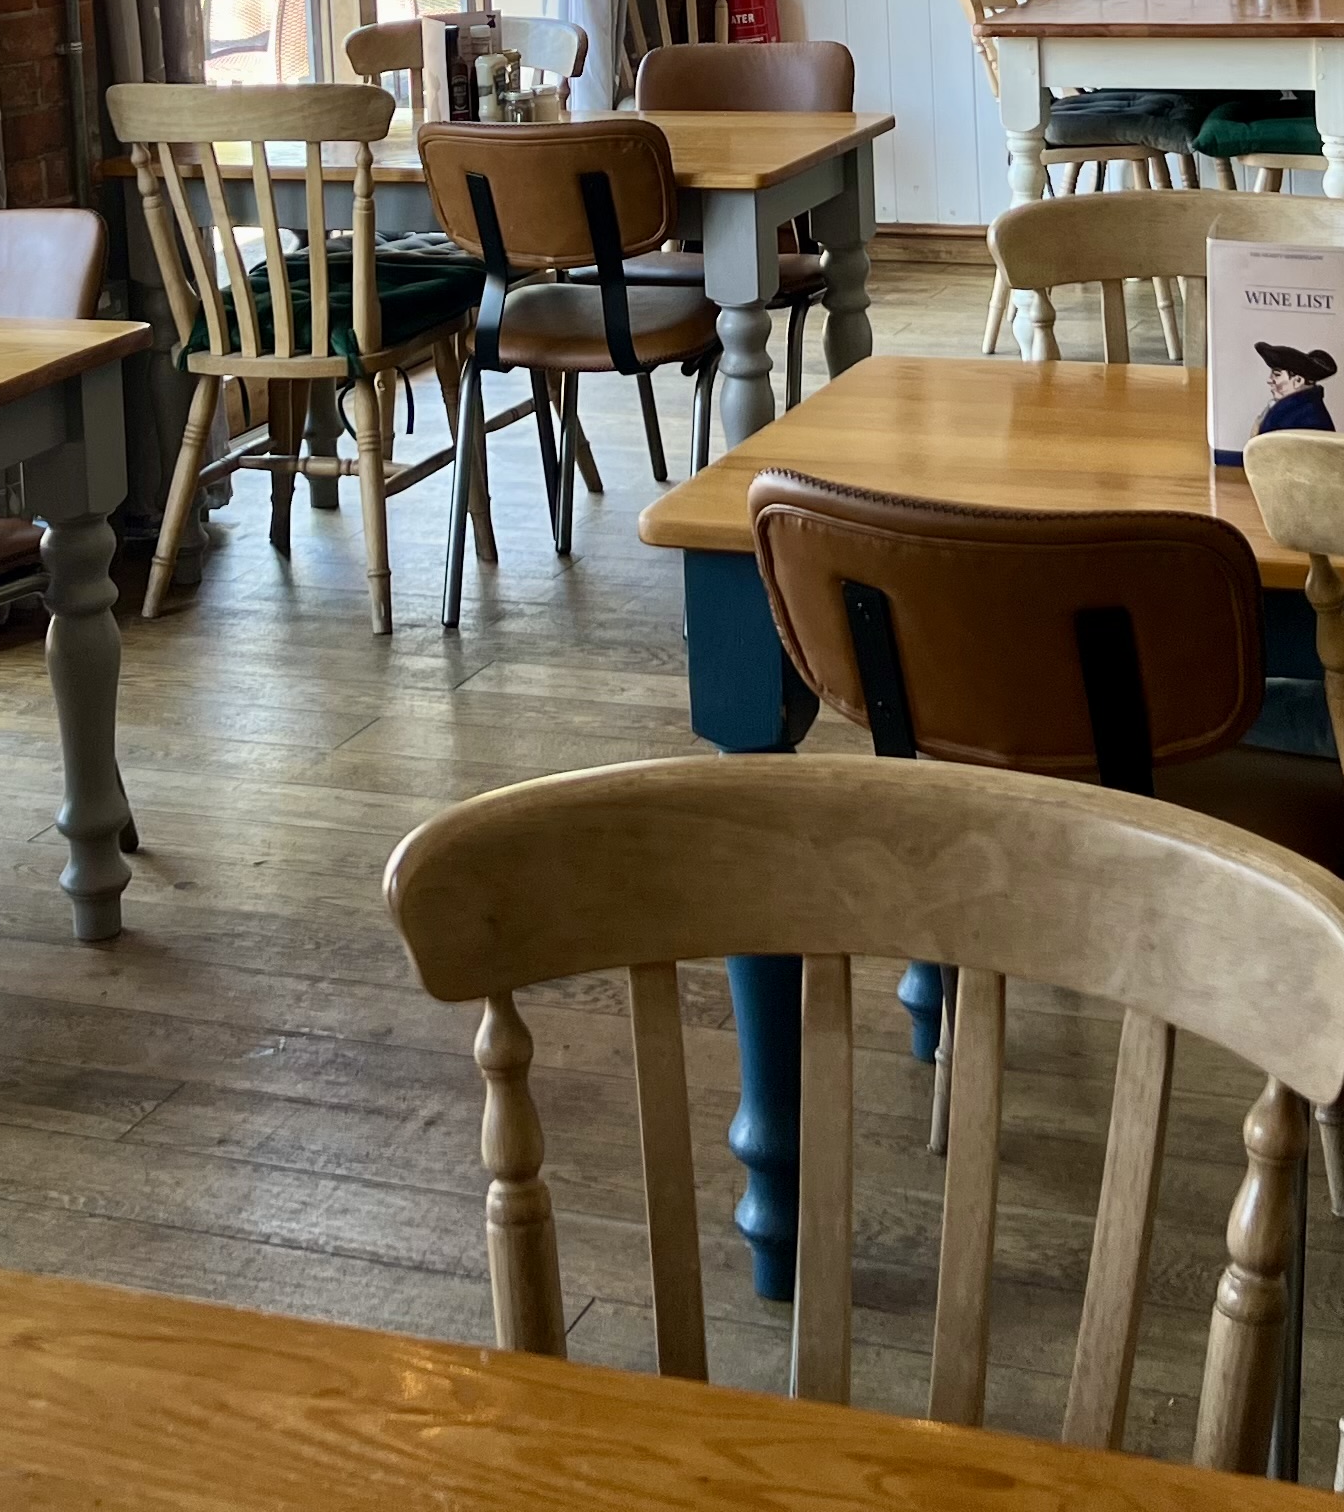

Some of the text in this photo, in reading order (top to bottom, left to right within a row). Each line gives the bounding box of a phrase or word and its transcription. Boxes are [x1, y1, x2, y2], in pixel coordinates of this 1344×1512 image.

[730, 13, 755, 25] ATER
[1244, 290, 1335, 310] WINE LIST
